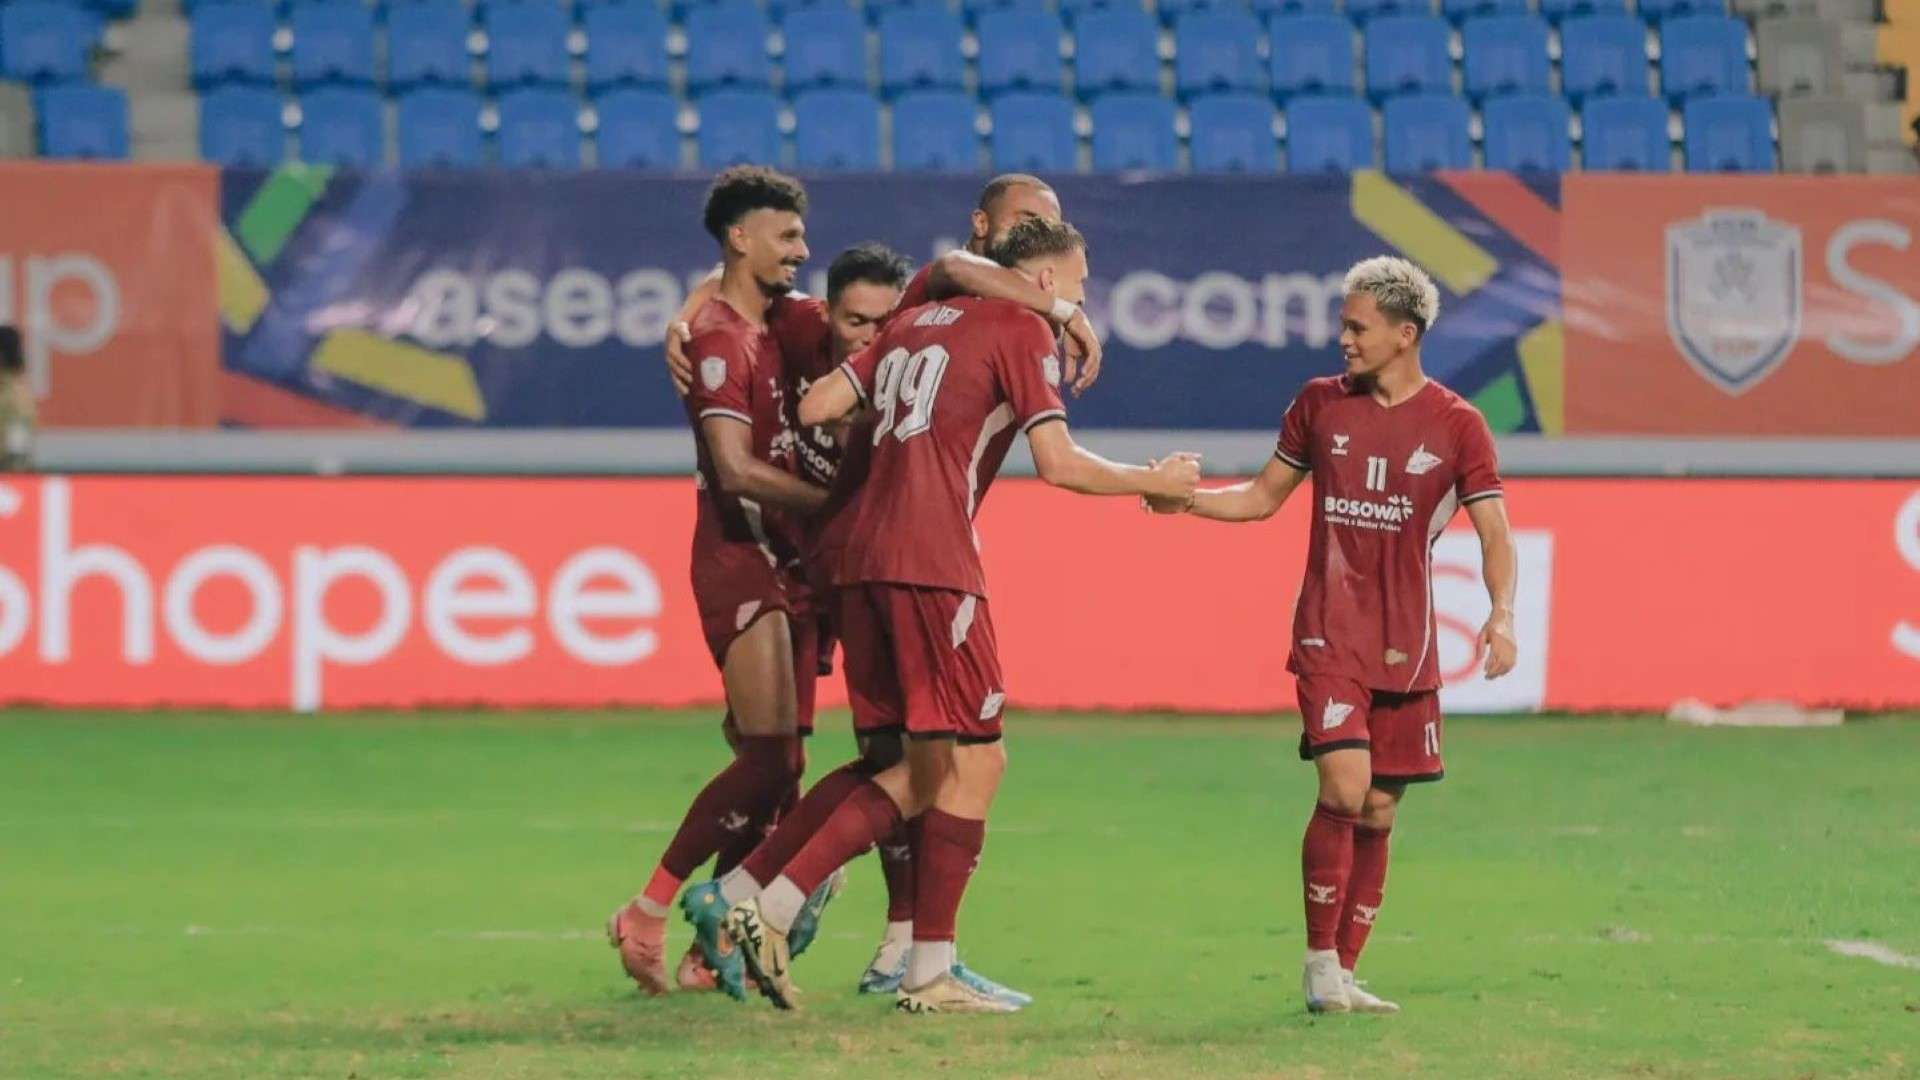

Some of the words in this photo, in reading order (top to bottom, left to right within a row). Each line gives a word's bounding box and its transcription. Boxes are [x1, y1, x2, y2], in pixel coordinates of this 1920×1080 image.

[1826, 217, 1920, 365] S
[873, 344, 950, 447] 99
[1365, 455, 1387, 492] 11
[1324, 496, 1402, 522] BOSOWA
[0, 471, 661, 712] hopee
[1424, 721, 1439, 757] 11
